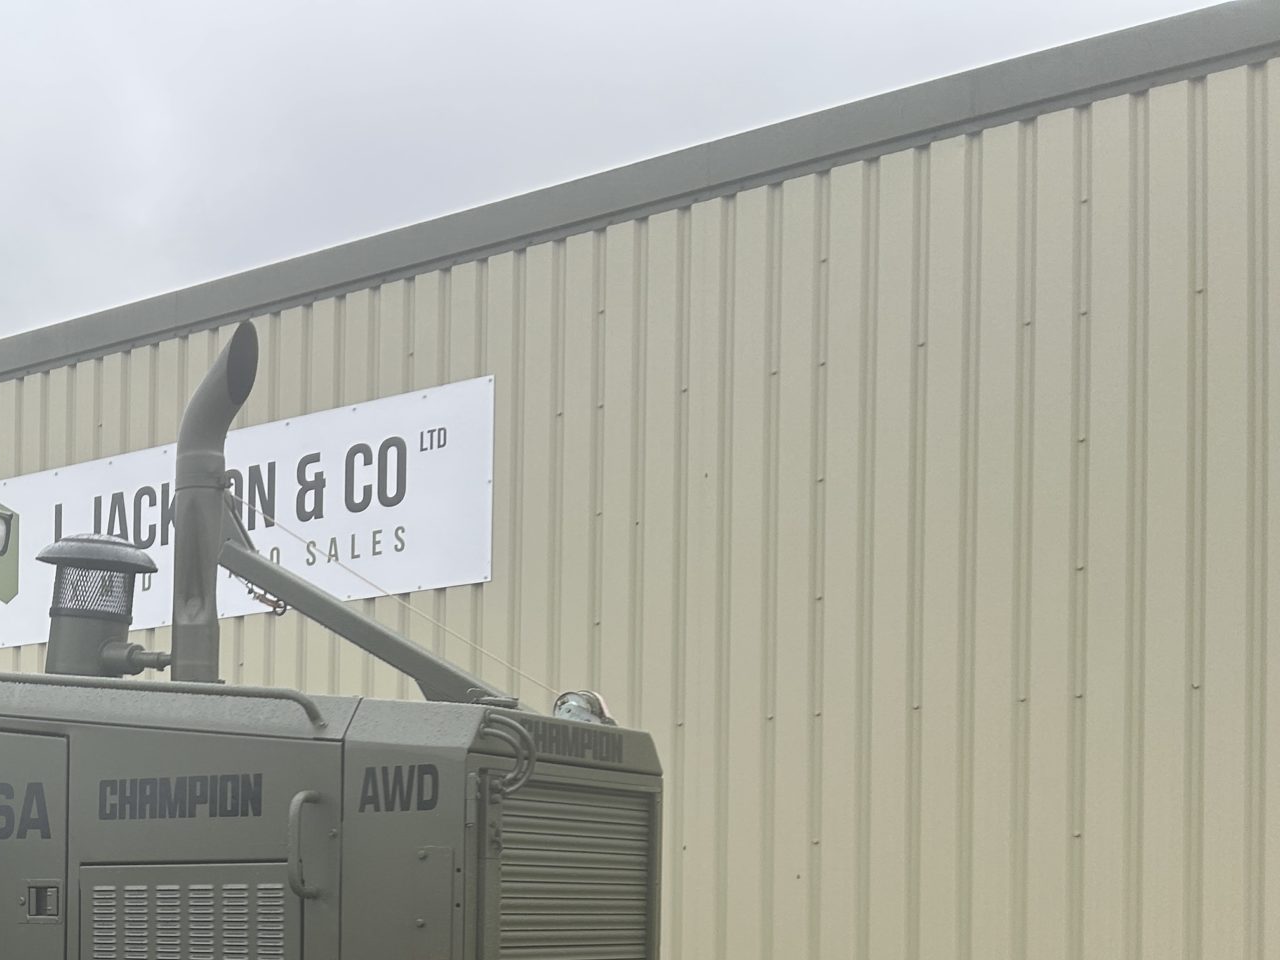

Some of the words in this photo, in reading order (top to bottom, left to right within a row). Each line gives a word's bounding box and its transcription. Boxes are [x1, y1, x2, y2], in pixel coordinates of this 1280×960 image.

[296, 451, 326, 522] &
[344, 436, 407, 513] CO
[419, 427, 447, 452] LTD
[306, 526, 405, 566] SALES
[98, 773, 263, 820] CHAMPION
[358, 763, 439, 812] AWD
